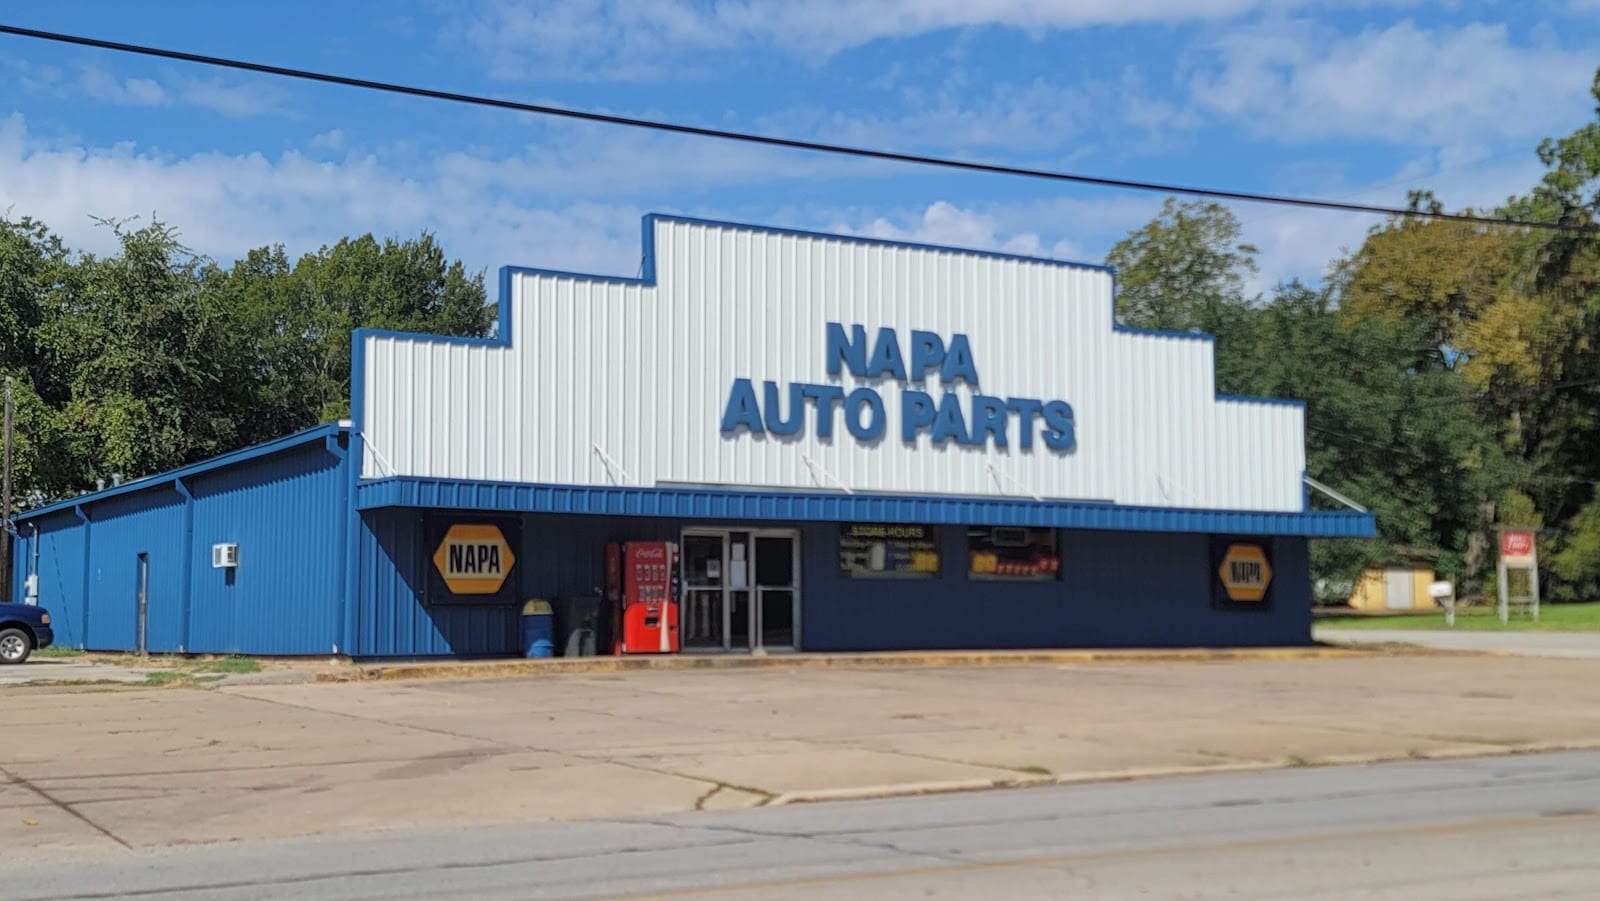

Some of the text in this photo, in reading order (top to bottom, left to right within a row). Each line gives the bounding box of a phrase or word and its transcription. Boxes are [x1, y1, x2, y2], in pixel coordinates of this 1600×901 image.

[826, 322, 978, 385] NAPA
[720, 378, 1075, 452] AUTO PARTS
[887, 527, 924, 538] HOURS
[449, 544, 500, 573] NAPA
